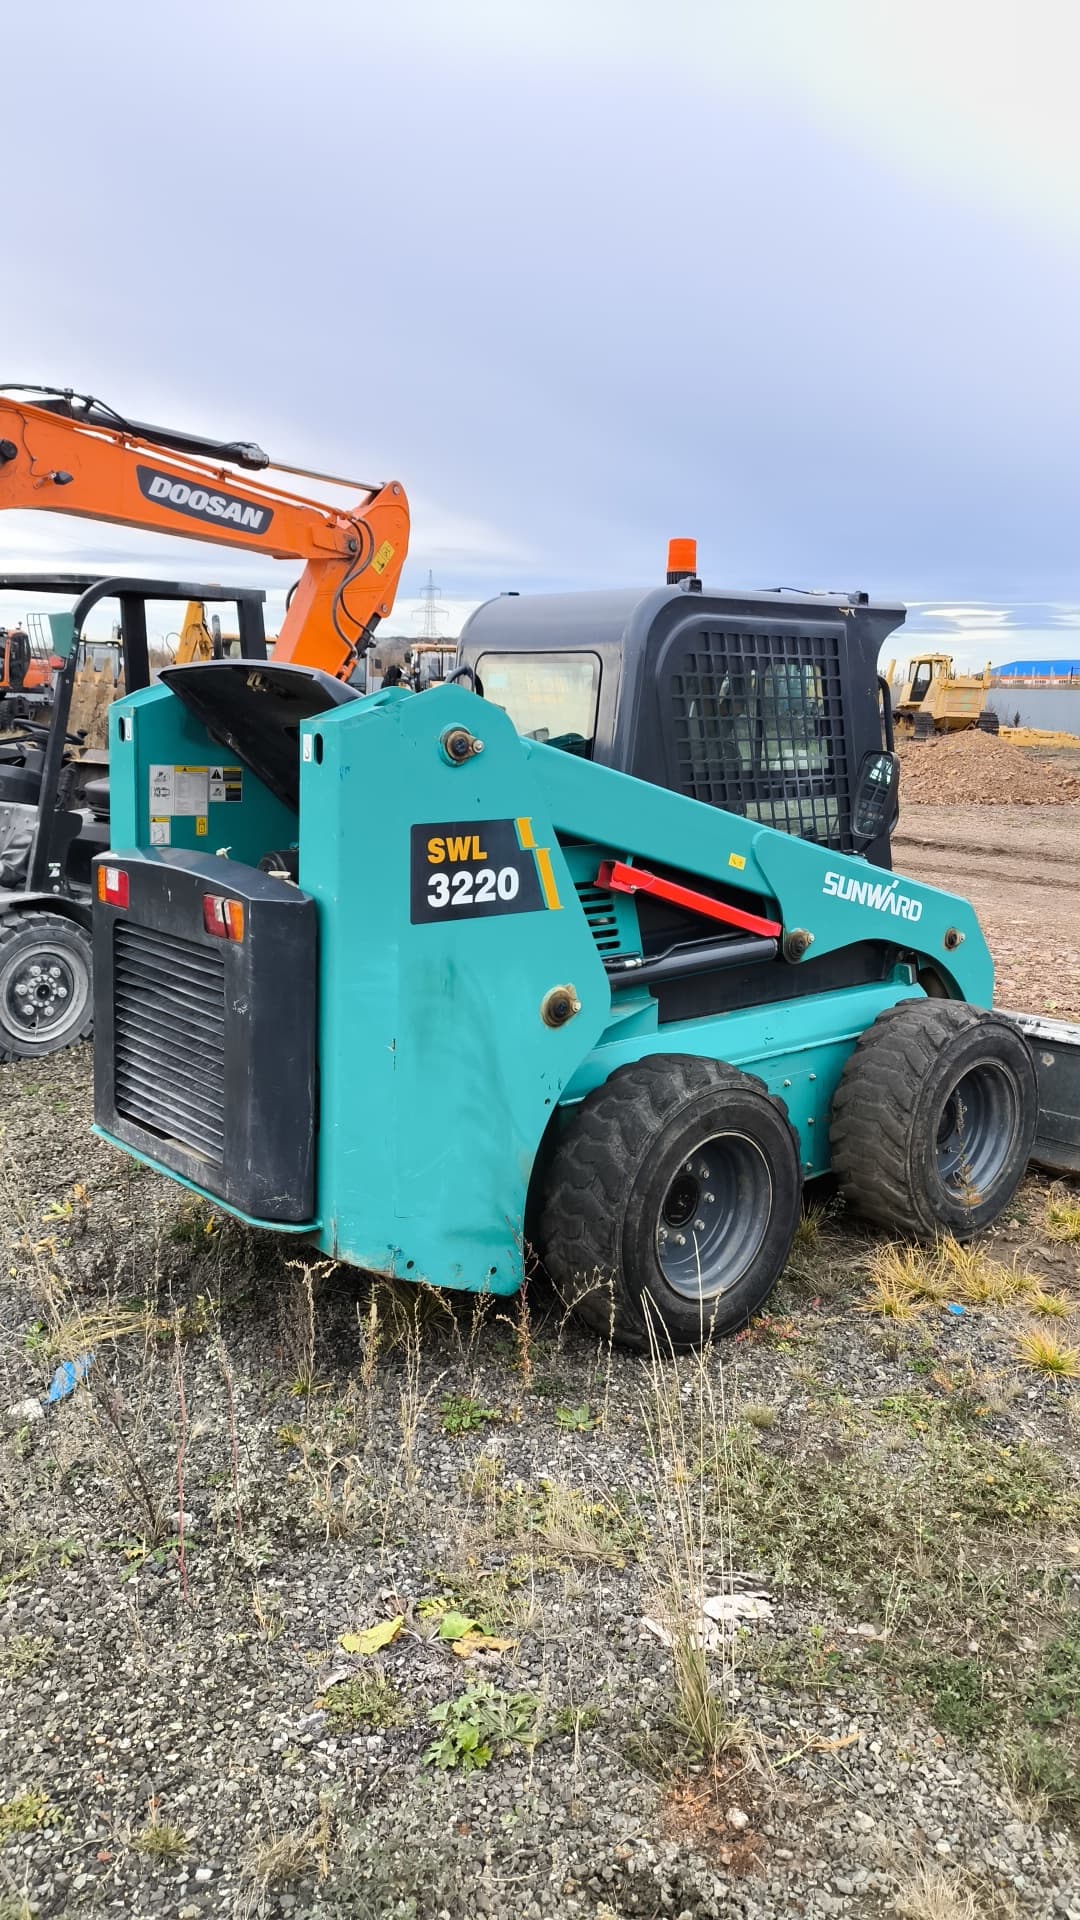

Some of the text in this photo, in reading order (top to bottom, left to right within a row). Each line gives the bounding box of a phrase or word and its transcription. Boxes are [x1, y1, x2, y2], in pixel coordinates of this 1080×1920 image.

[148, 476, 264, 529] DOOSAN
[427, 836, 487, 863] SWL
[427, 867, 519, 908] 3220
[823, 872, 922, 922] SUNWARD
